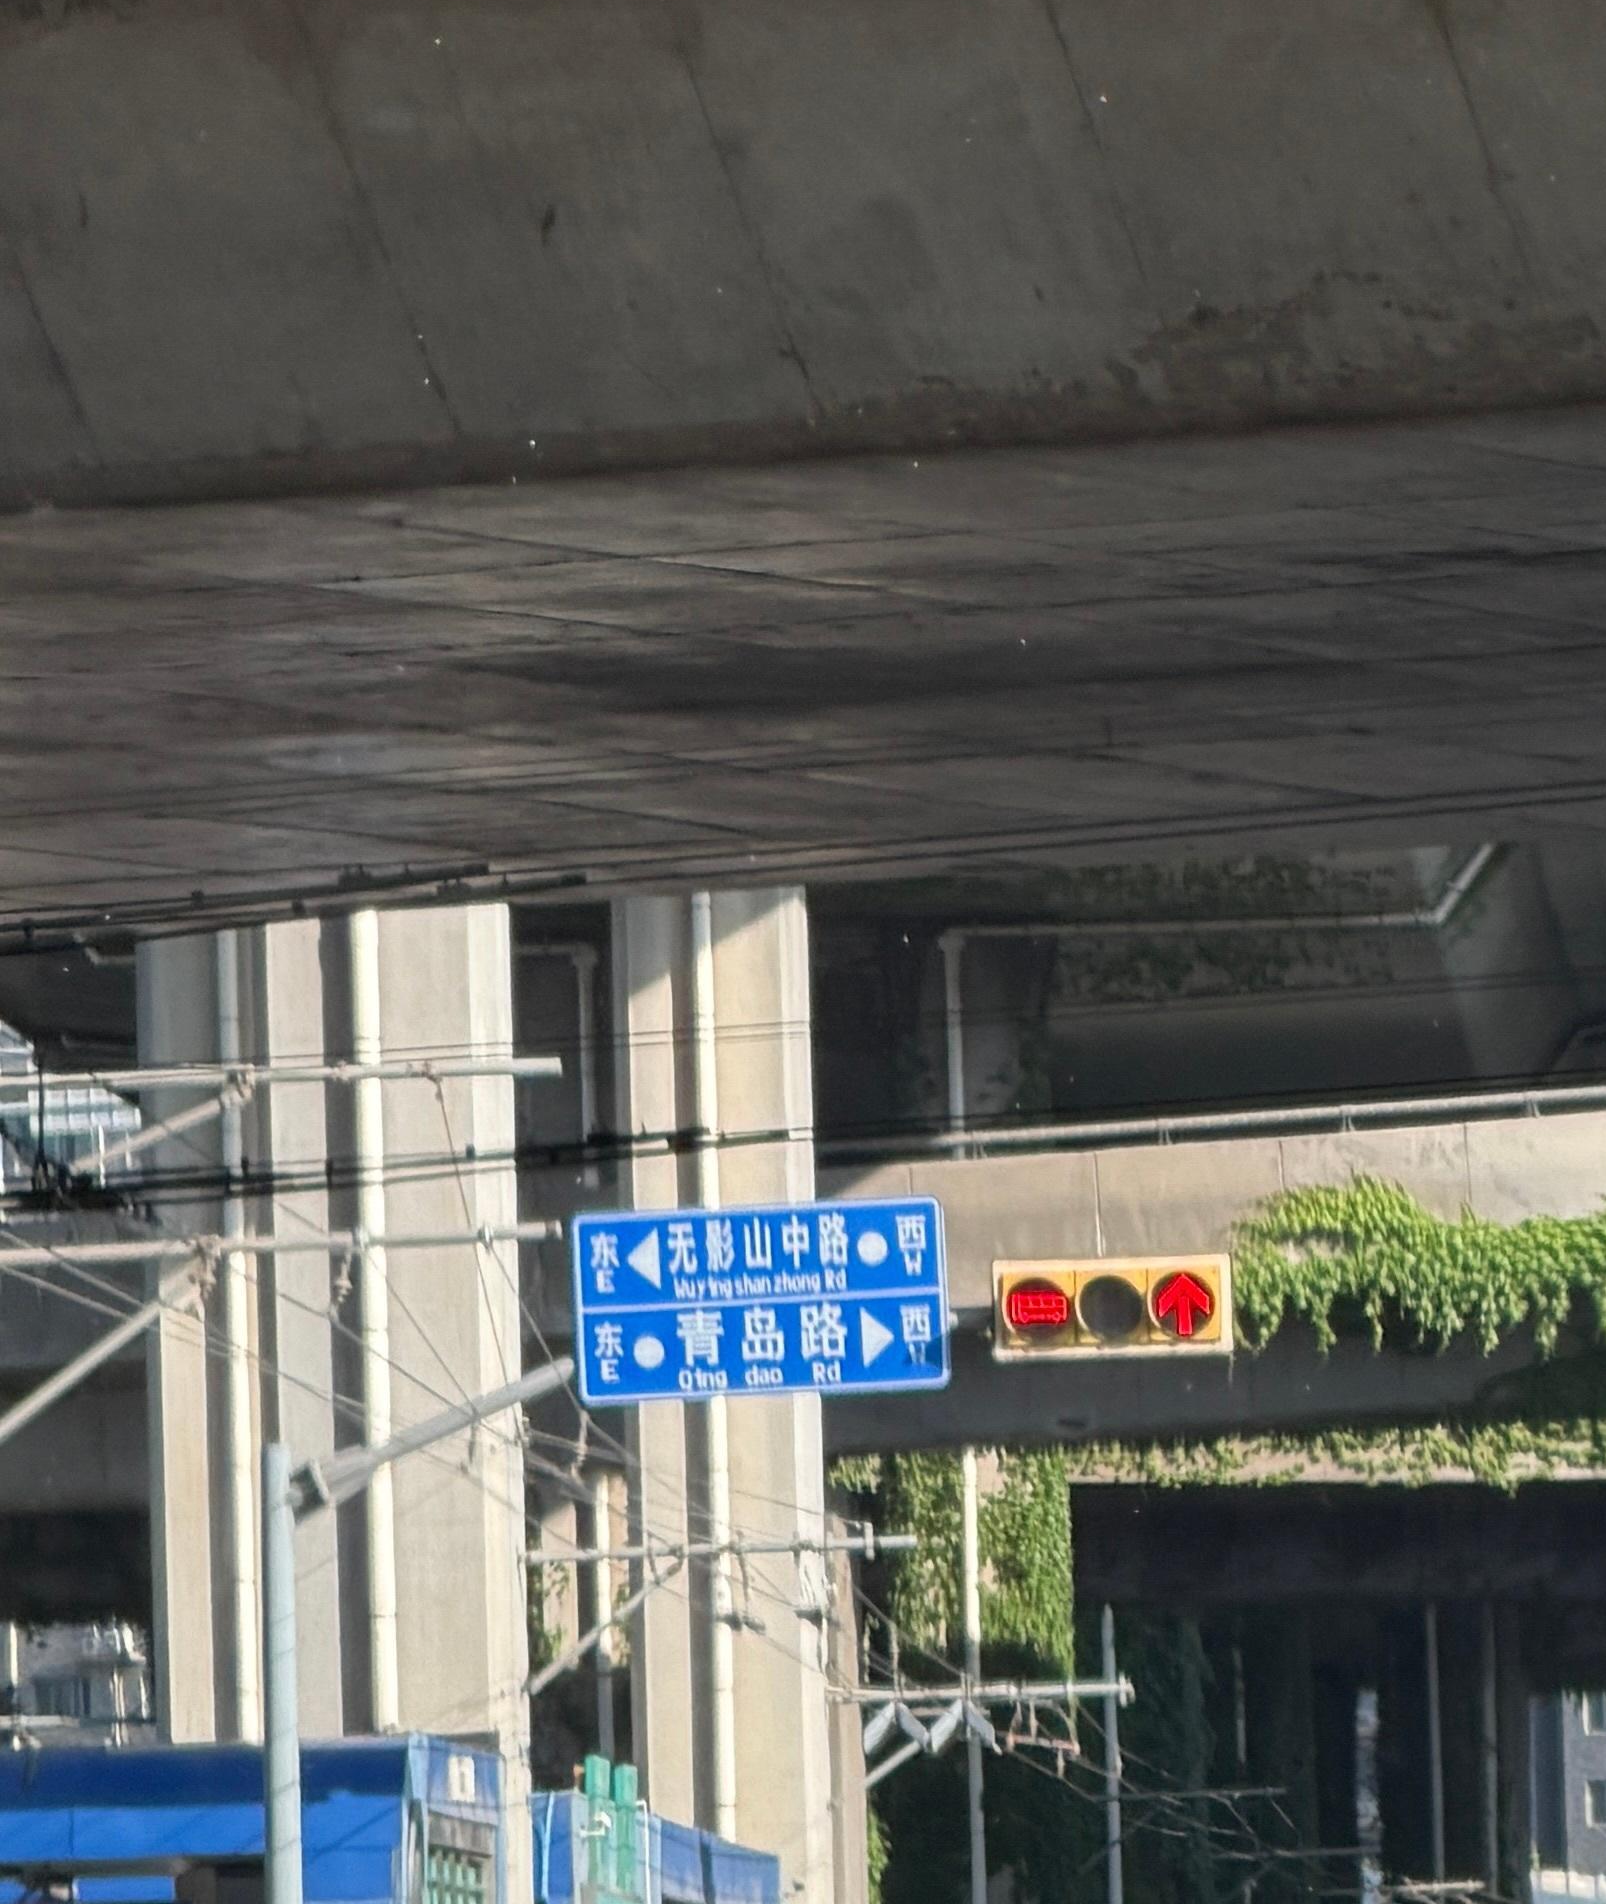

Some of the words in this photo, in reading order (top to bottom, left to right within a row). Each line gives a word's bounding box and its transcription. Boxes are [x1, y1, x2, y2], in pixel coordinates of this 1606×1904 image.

[590, 1232, 620, 1268] 东
[667, 1212, 848, 1275] 无影山中路
[895, 1215, 926, 1250] 西
[824, 1268, 848, 1291] Rd
[904, 1250, 922, 1276] W
[596, 1269, 615, 1293] E
[594, 1321, 624, 1358] 东
[676, 1301, 848, 1367] 青岛路
[900, 1303, 931, 1342] 西
[601, 1358, 620, 1383] E
[812, 1359, 842, 1384] Rd
